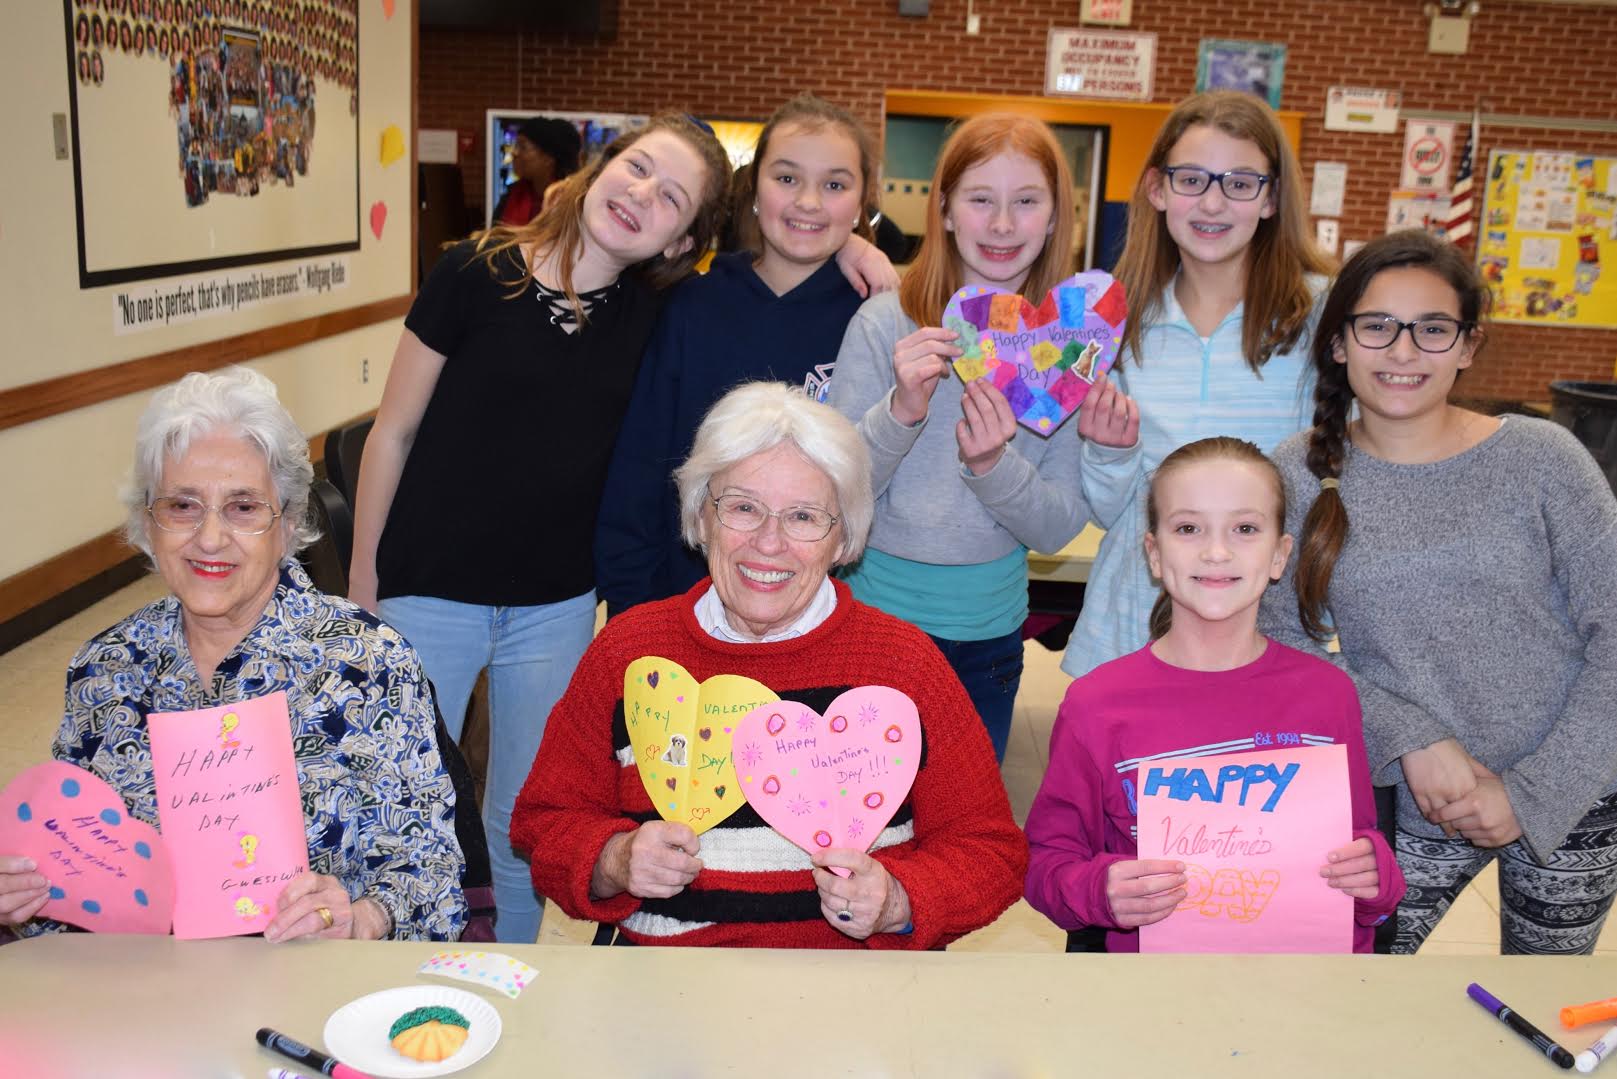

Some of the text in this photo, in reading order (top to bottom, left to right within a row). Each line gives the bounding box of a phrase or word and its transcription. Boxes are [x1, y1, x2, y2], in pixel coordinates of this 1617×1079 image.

[1069, 38, 1136, 50] MAXIMUM
[1061, 52, 1140, 65] OCCUPANCY
[1083, 80, 1142, 92] PERSONS
[137, 297, 153, 323] one
[155, 289, 163, 320] is
[165, 286, 197, 325] perfect,
[198, 280, 220, 311] that's
[220, 276, 235, 312] why
[236, 273, 260, 311] pencils
[260, 271, 275, 298] have
[992, 331, 1037, 351] Happy
[1017, 363, 1052, 389] Day
[775, 737, 817, 755] HAPPY
[1276, 731, 1300, 745] 1994
[171, 745, 254, 778] HAPPY
[1143, 762, 1301, 813] HAPPY
[198, 813, 240, 832] DAY
